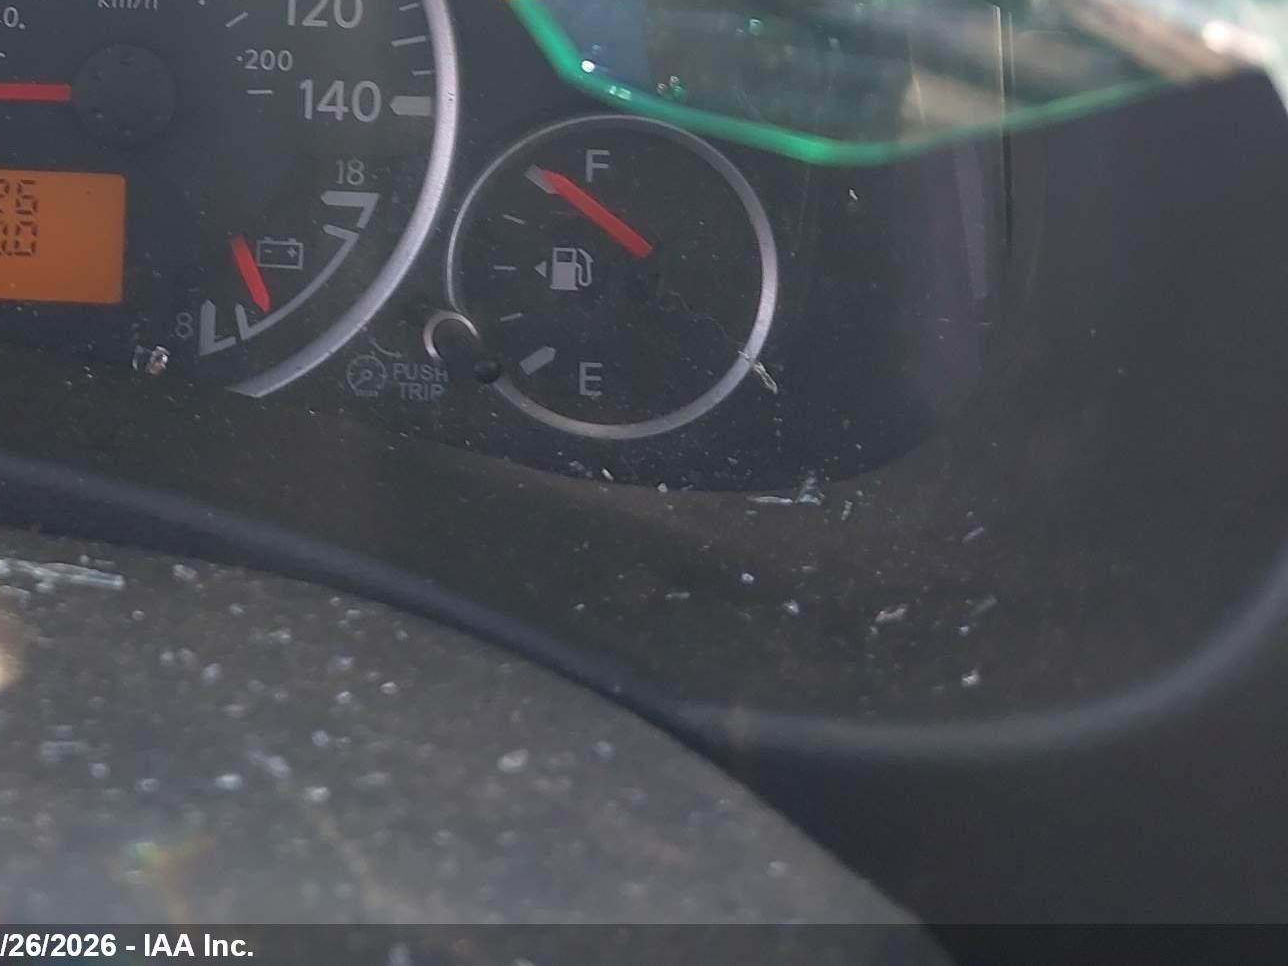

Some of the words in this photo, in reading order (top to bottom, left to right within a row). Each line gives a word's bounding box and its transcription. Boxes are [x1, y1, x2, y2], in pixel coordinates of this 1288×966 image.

[244, 49, 293, 71] 200
[299, 80, 381, 123] 140
[336, 160, 365, 186] 18
[586, 149, 610, 182] F
[175, 312, 194, 339] 8
[392, 362, 448, 382] PUSH
[578, 362, 602, 397] E
[399, 383, 445, 401] TRIP
